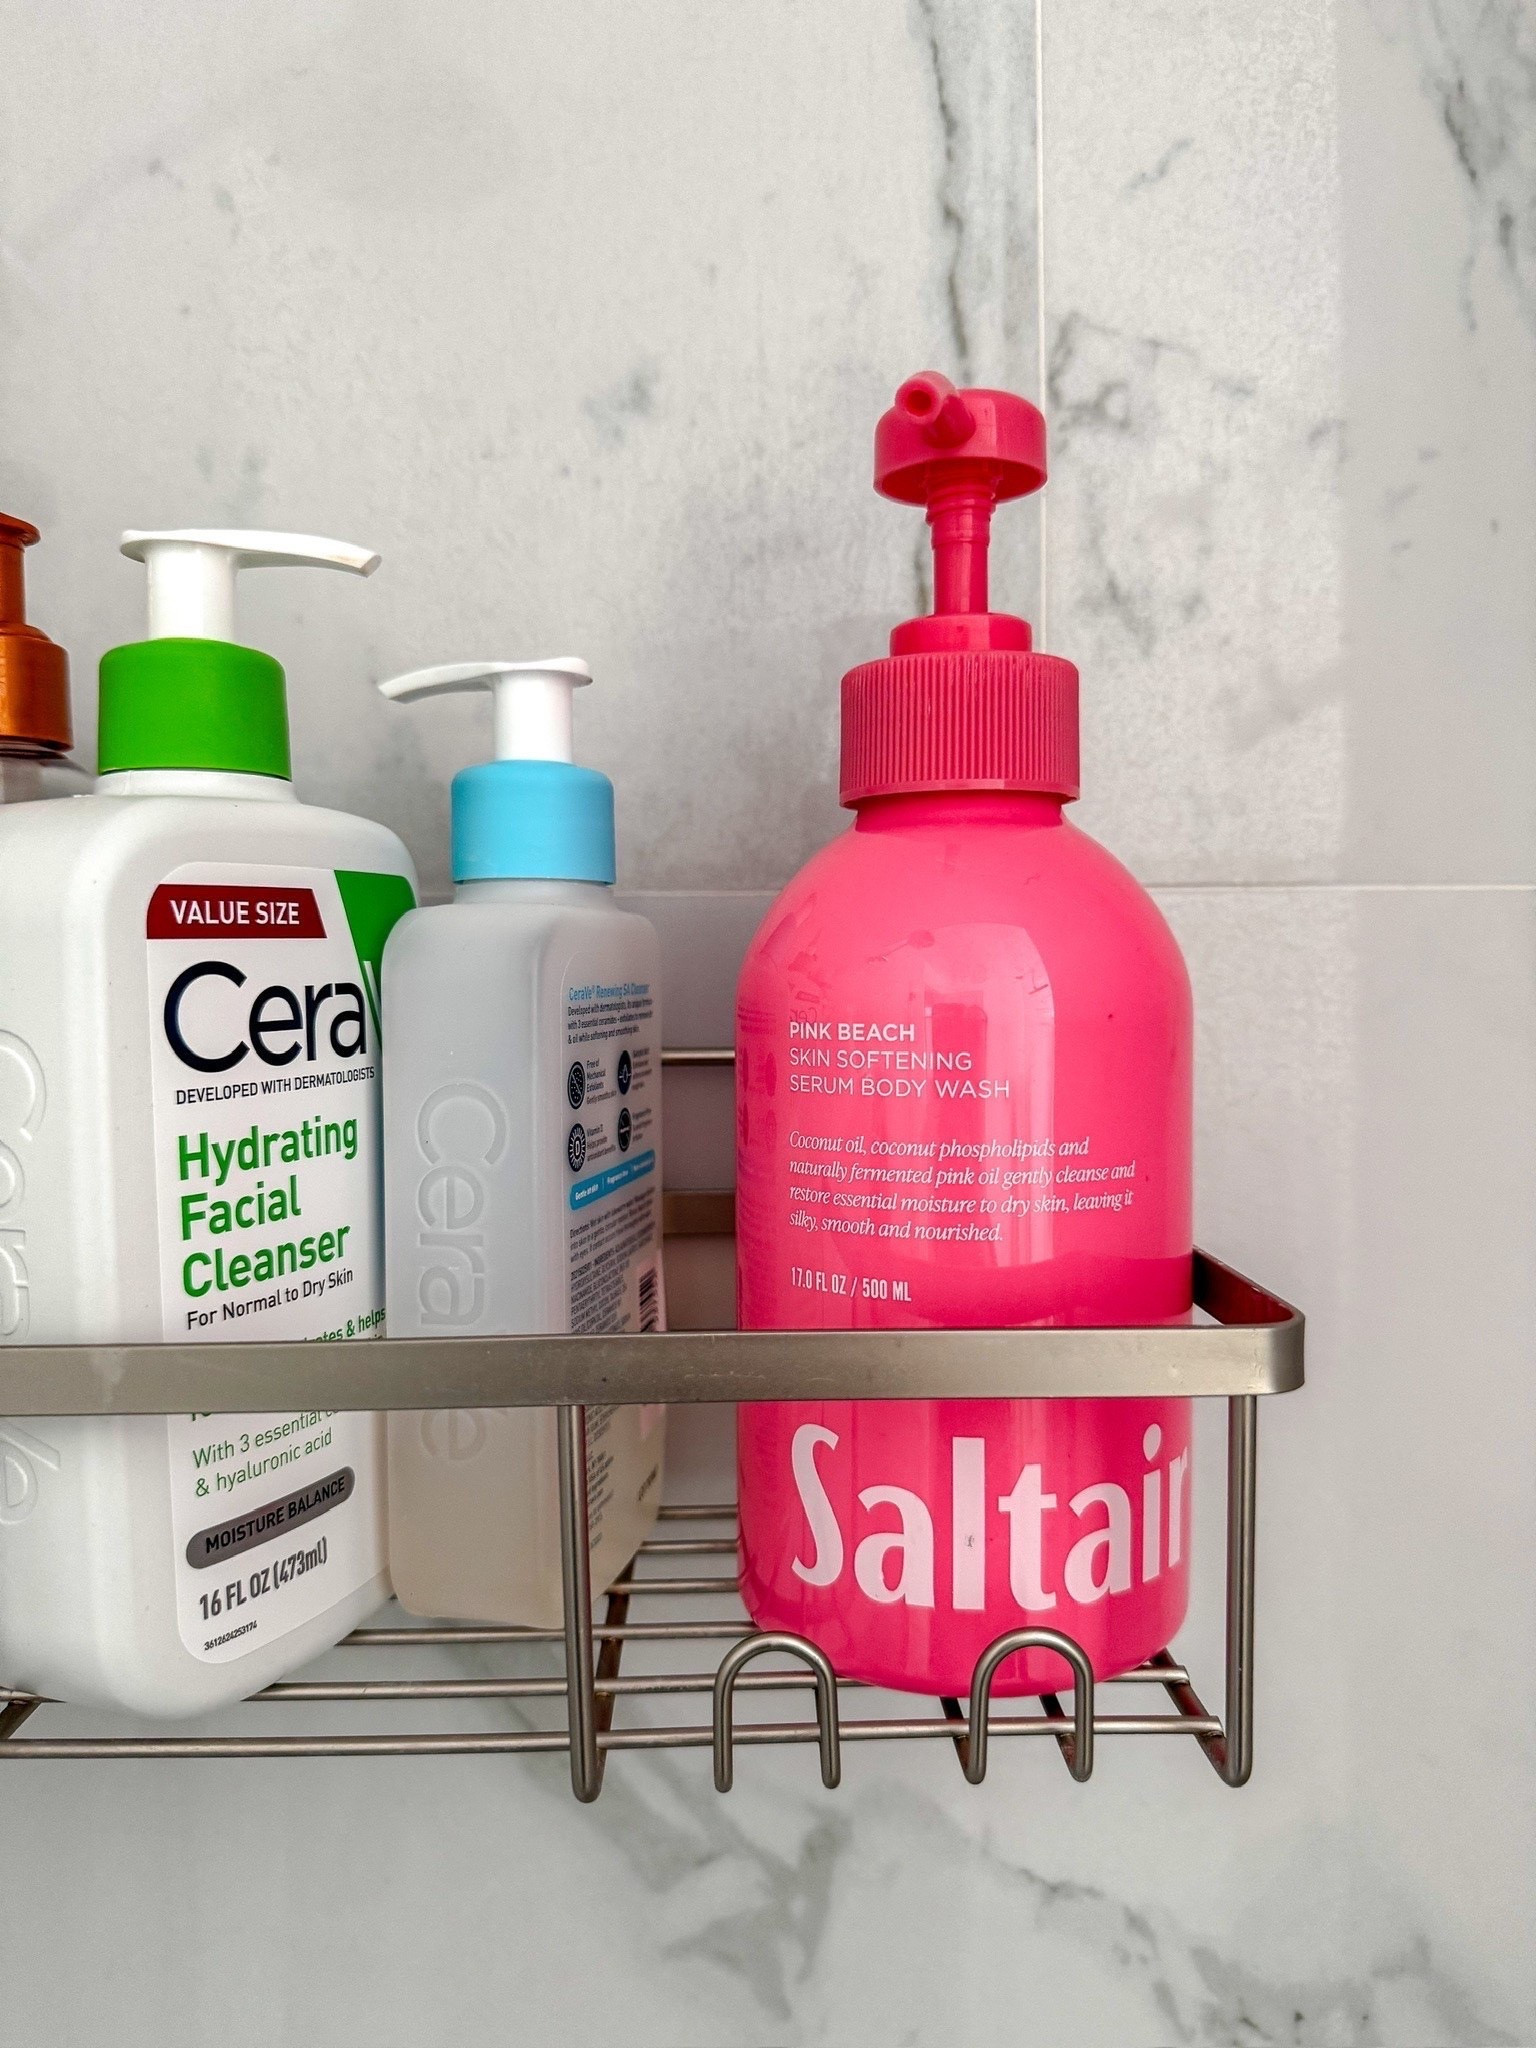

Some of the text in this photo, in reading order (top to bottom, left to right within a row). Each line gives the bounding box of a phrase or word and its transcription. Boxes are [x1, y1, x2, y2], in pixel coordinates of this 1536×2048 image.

[169, 899, 300, 926] VALUE SIZE
[789, 1021, 915, 1042] PINK BEACH
[789, 1047, 973, 1071] SKIN SOFTENING
[175, 1066, 375, 1105] DEVELOPED WITH DERMATOLOGISTS
[789, 1074, 1010, 1099] SERUM BODY WASH
[178, 1115, 358, 1187] Hydrating
[789, 1130, 1090, 1162] Coconut oil, coconut phospholipids and
[789, 1159, 1136, 1190] naturally fermented pink oil gently cleanse and
[180, 1174, 302, 1241] Facial
[789, 1186, 1134, 1218] restore essential moisture to dry skin, leaving it
[789, 1210, 1004, 1242] silky, smooth and nourished.
[182, 1225, 351, 1298] Cleanser
[187, 1267, 353, 1330] For Normal to Dry Skin
[790, 1267, 912, 1302] 17.0 FL OZ / 500 ML
[346, 1319, 356, 1336] &
[358, 1305, 386, 1333] helps
[192, 1411, 322, 1469] With 3 essential
[195, 1427, 333, 1498] & hyaluronic acid
[205, 1476, 346, 1553] MOISTURE BALANCE
[790, 1423, 1188, 1612] Saltair
[199, 1536, 328, 1620] 16 FL OZ (473ml)
